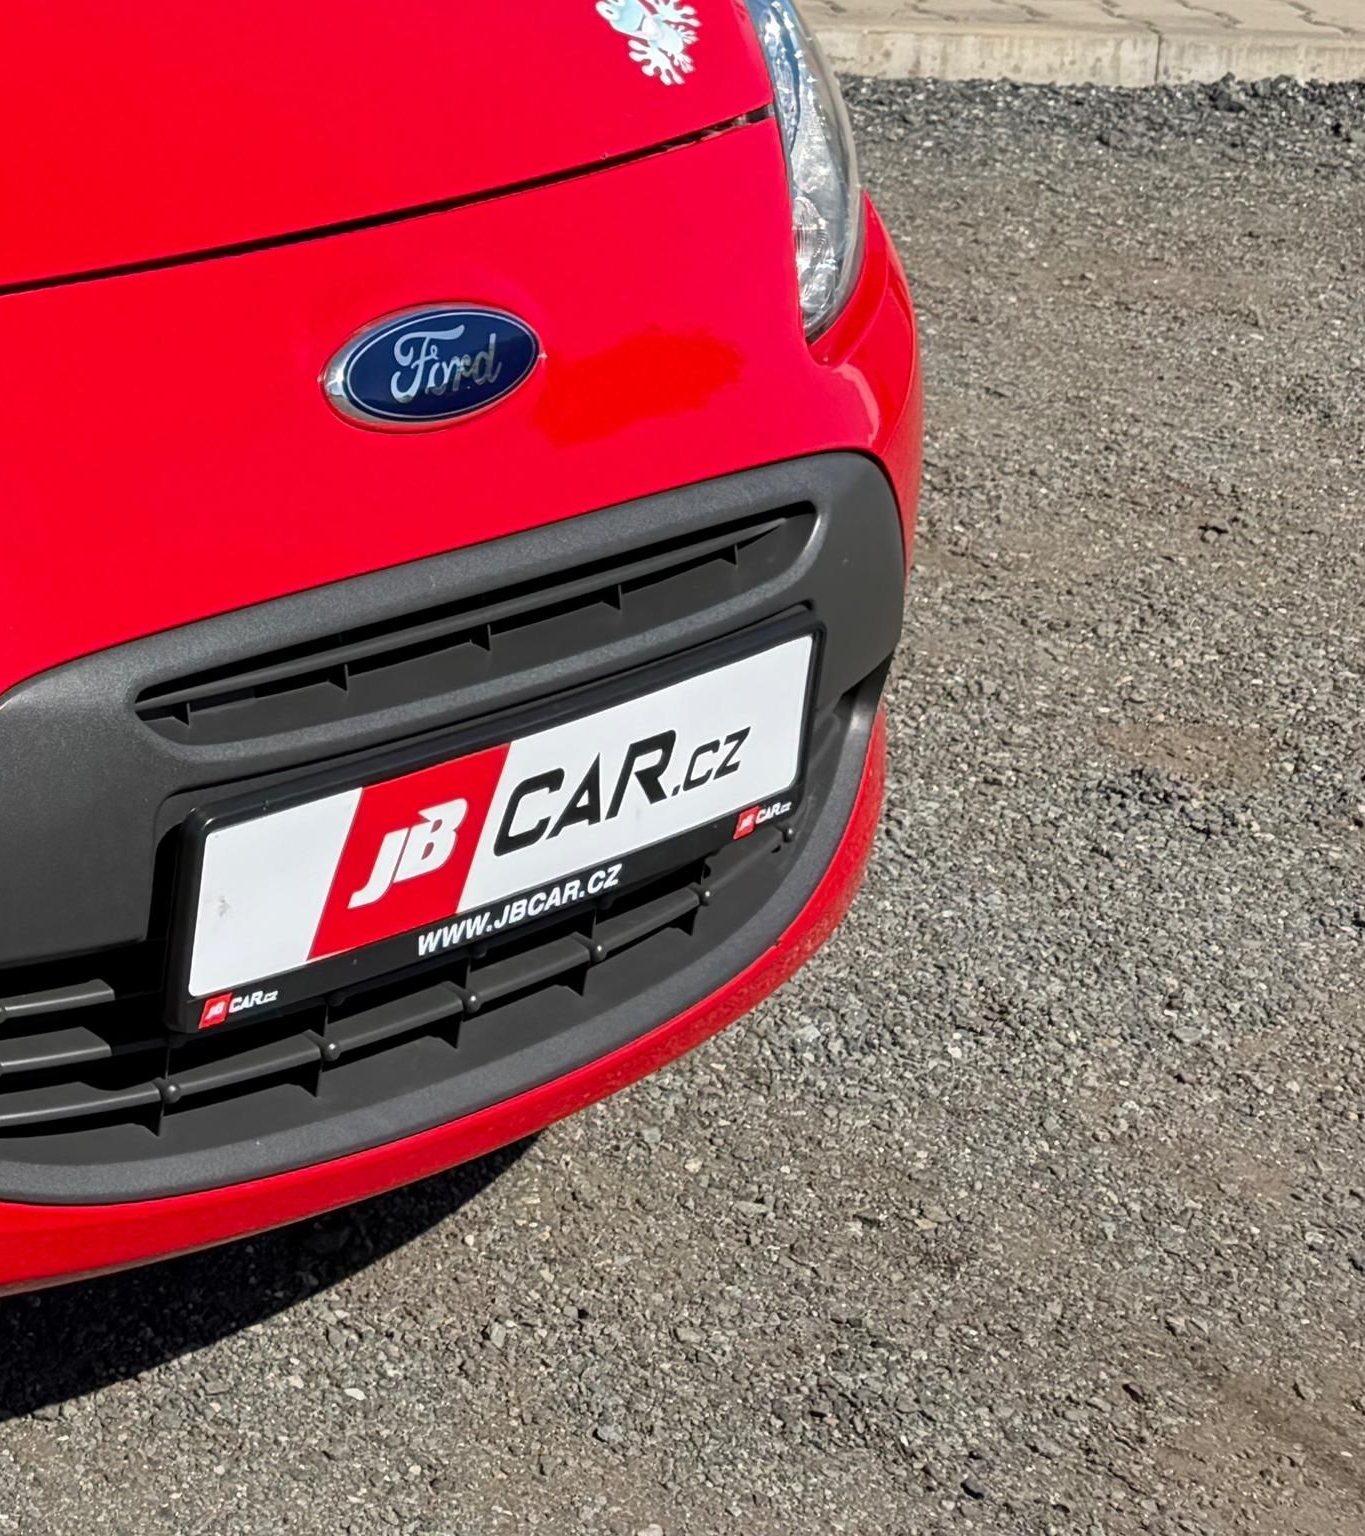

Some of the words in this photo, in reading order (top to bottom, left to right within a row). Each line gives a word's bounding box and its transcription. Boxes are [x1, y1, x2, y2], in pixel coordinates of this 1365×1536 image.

[390, 324, 502, 404] Ford
[347, 797, 469, 909] JB
[418, 862, 623, 957] WWW.JBCAR.CZ
